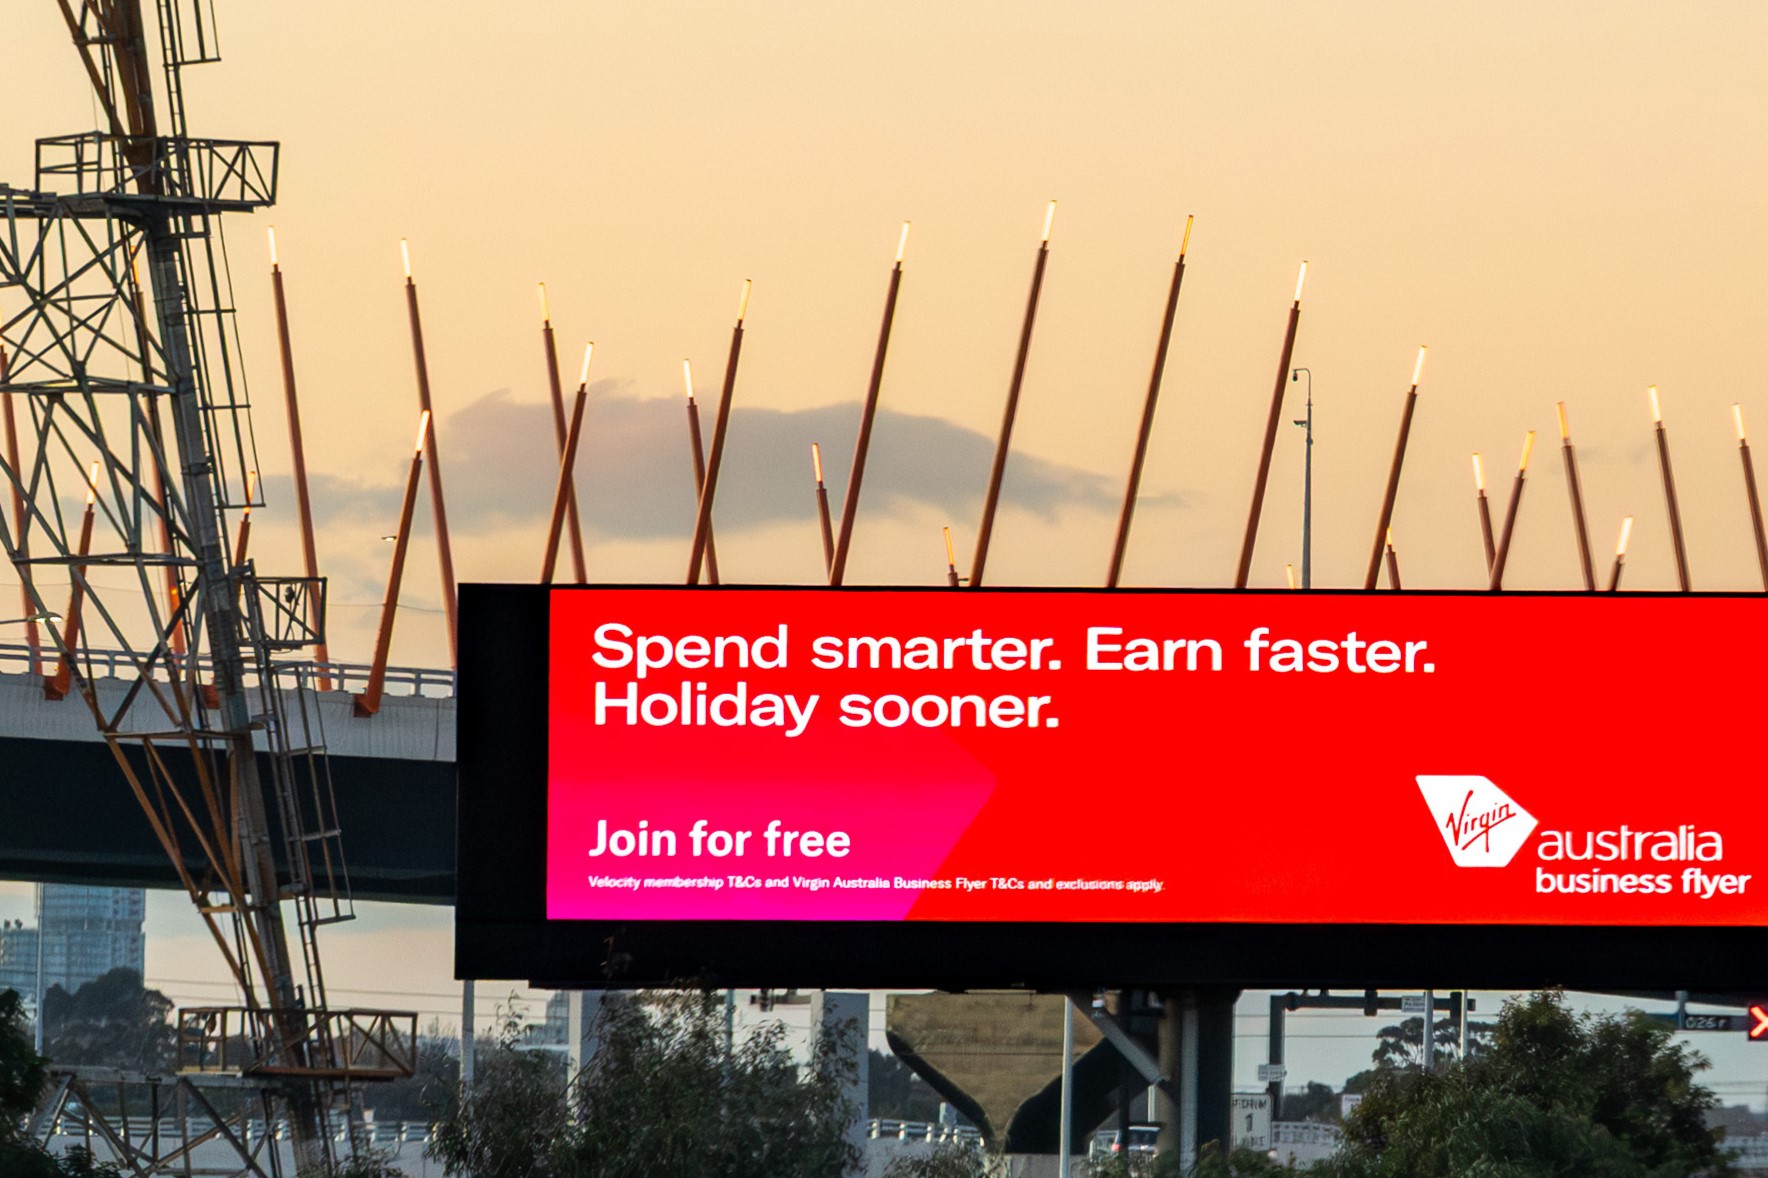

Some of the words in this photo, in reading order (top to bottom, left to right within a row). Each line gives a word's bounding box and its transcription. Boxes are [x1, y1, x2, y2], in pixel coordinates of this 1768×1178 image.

[592, 623, 788, 679] Spend
[811, 629, 1062, 671] smarter.
[1086, 627, 1222, 672] Earn
[1244, 627, 1436, 673] faster.
[595, 681, 820, 738] Holiday
[839, 694, 1060, 729] sooner.
[588, 819, 677, 857] Join
[688, 819, 752, 857] for
[763, 819, 850, 857] free
[1446, 789, 1517, 853] Virgin
[1537, 824, 1723, 862] australia
[588, 875, 640, 891] Velocity
[643, 875, 724, 891] membership
[727, 876, 762, 888] T&Cs
[765, 876, 789, 888] and
[792, 876, 829, 891] Virgin
[833, 877, 890, 889] Australia
[893, 877, 952, 889] Business
[955, 877, 987, 892] Flyer
[990, 877, 1024, 890] T&Cs
[1027, 878, 1053, 890] and
[1056, 879, 1124, 891] exclusions
[1536, 867, 1672, 894] business
[1682, 868, 1752, 899] flyer
